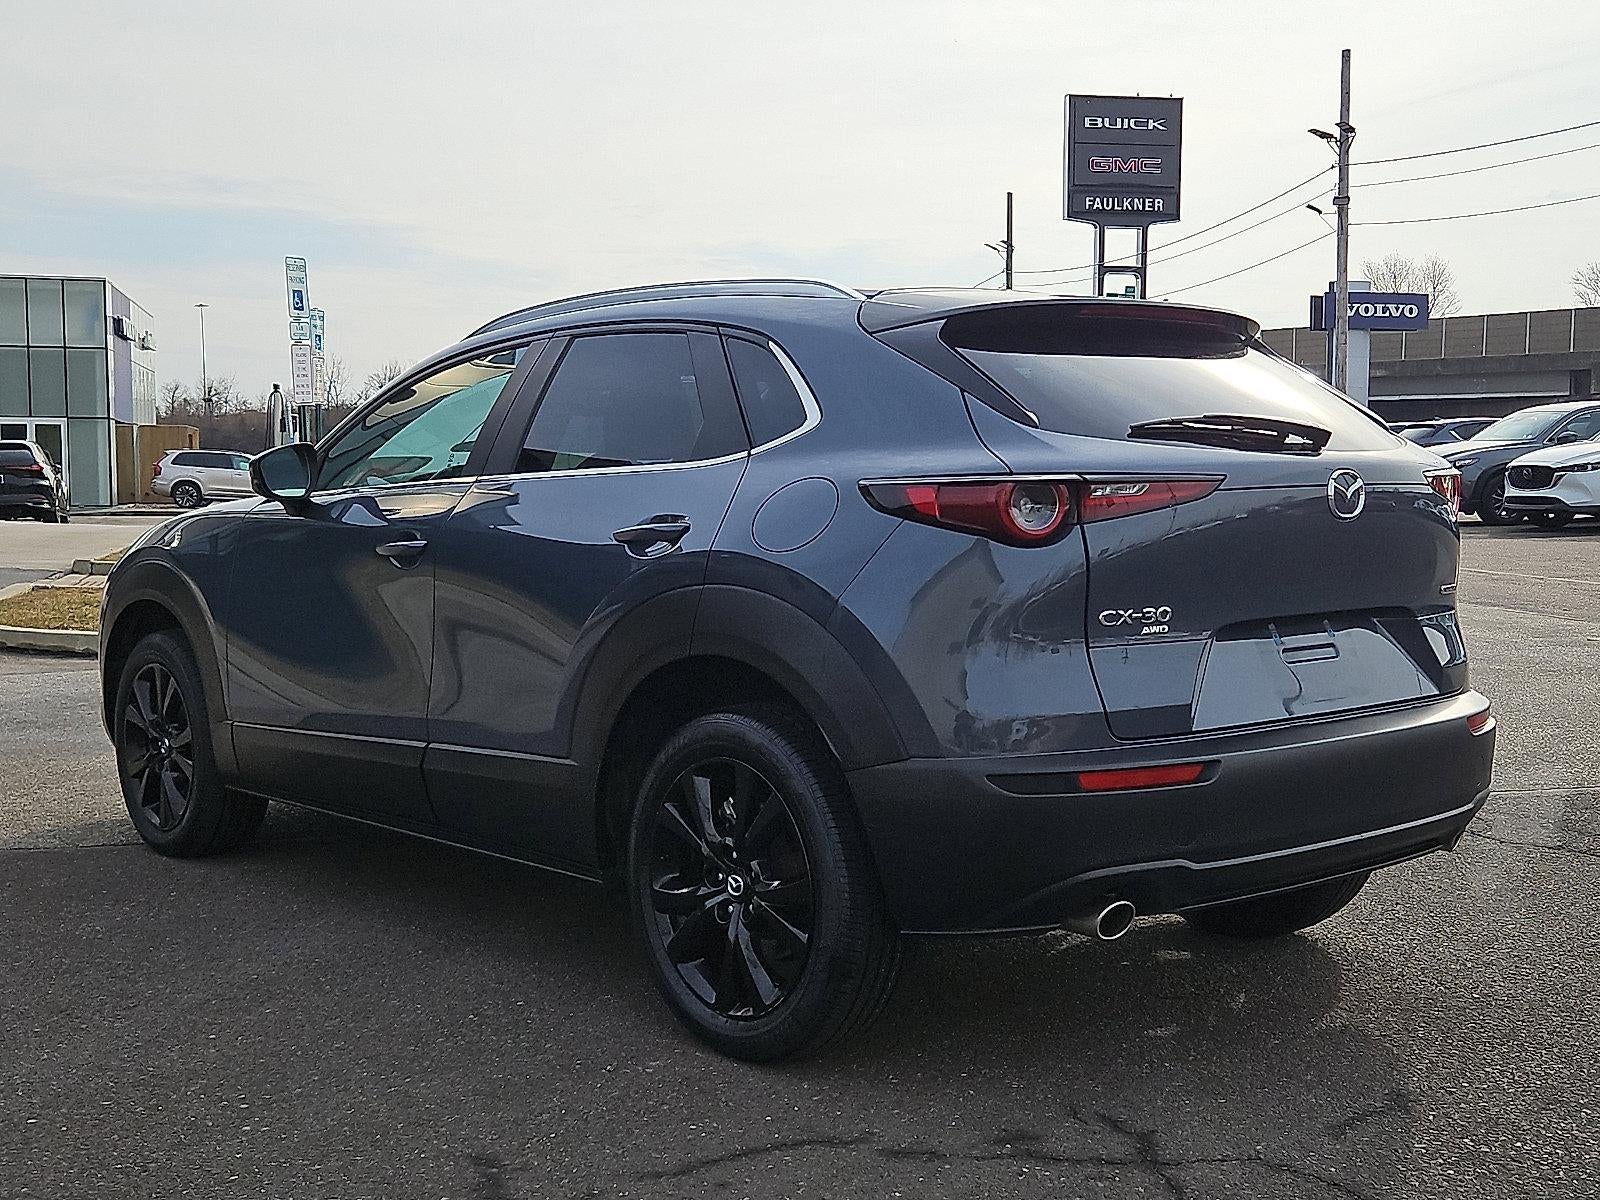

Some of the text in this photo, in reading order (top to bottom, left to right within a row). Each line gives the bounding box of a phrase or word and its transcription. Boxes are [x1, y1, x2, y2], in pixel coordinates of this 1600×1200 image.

[1084, 116, 1168, 131] BUICK
[1089, 157, 1162, 173] GMC
[1085, 196, 1164, 211] FAULKNER
[1347, 303, 1419, 318] VOLVO
[1098, 606, 1172, 626] CX-30
[1141, 625, 1169, 635] AWD
